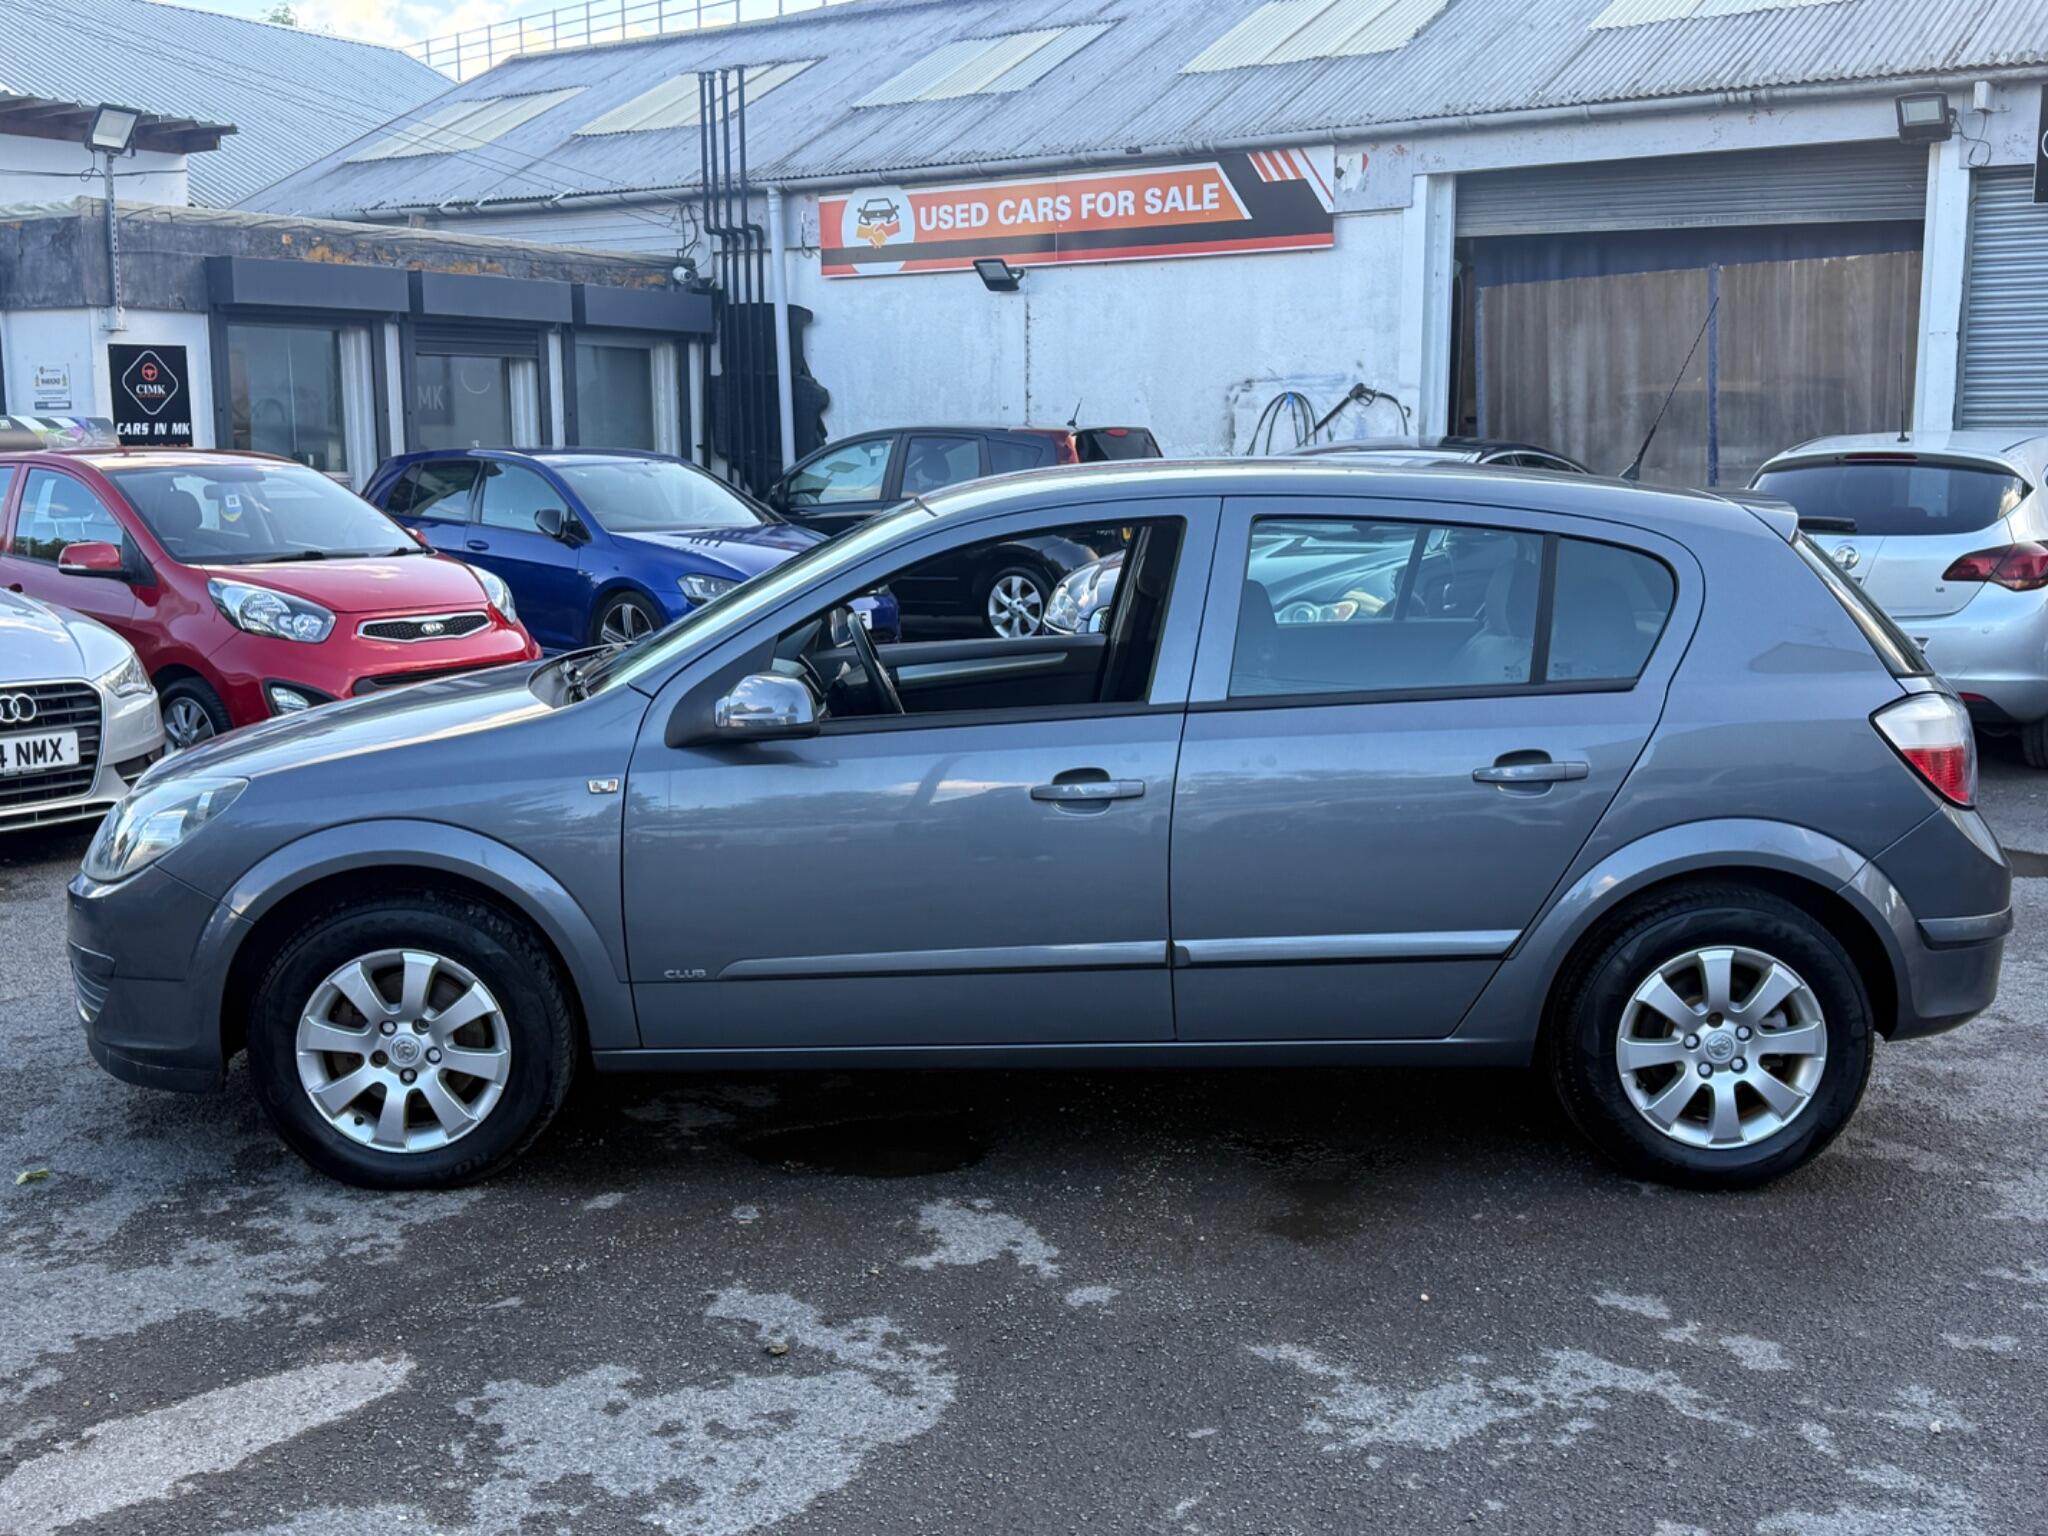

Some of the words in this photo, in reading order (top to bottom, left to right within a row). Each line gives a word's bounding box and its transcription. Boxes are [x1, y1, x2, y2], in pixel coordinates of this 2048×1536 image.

[920, 202, 989, 231] USED
[998, 195, 1072, 225] CARS
[1081, 190, 1135, 219] FOR
[1144, 182, 1220, 214] SALE
[135, 383, 166, 394] CIMK
[117, 422, 149, 435] CARS
[154, 422, 167, 435] IN
[172, 422, 190, 435] MK
[16, 737, 63, 766] NMX
[663, 968, 707, 979] CLUB
